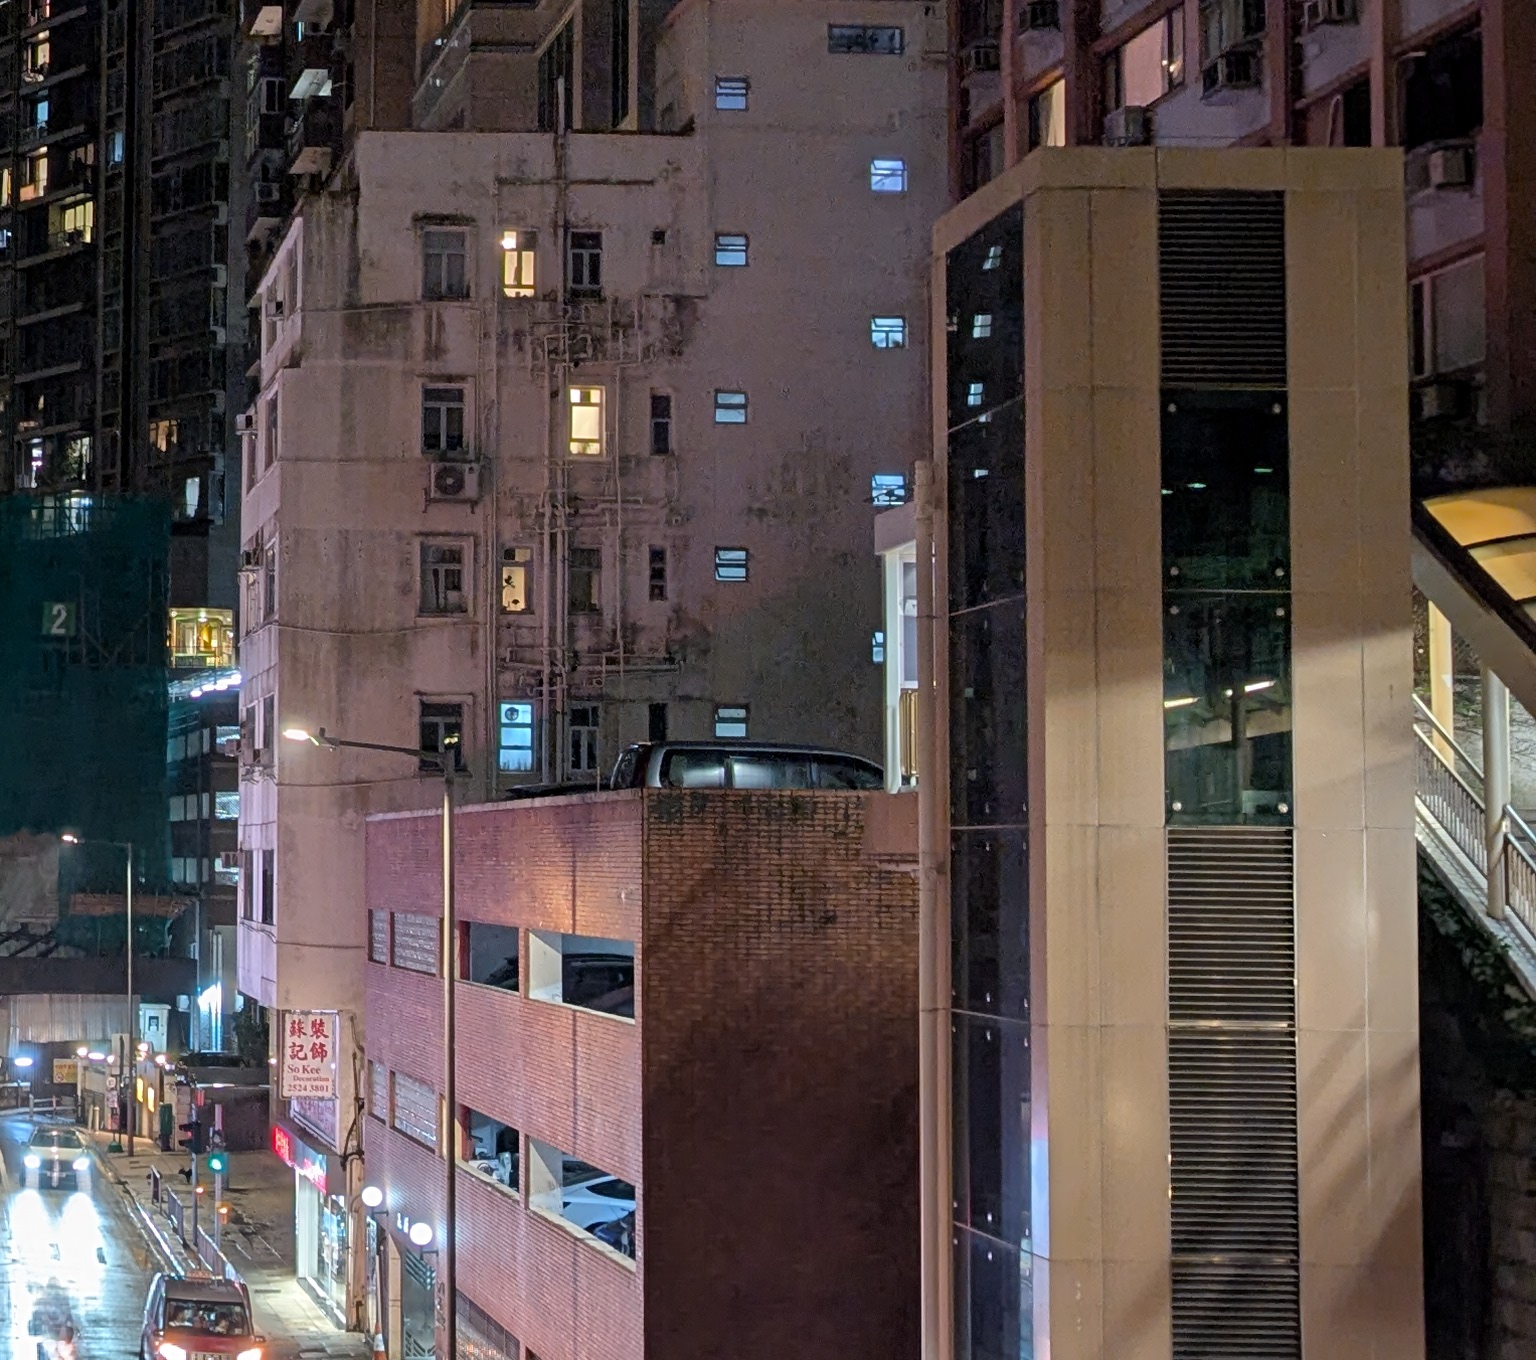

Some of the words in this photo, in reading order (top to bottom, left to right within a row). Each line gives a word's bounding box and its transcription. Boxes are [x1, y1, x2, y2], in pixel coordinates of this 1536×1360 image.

[50, 604, 68, 635] 2
[287, 1064, 300, 1074] So
[302, 1064, 321, 1074] Kee
[287, 1084, 308, 1092] 2524
[309, 1084, 329, 1092] 3801
